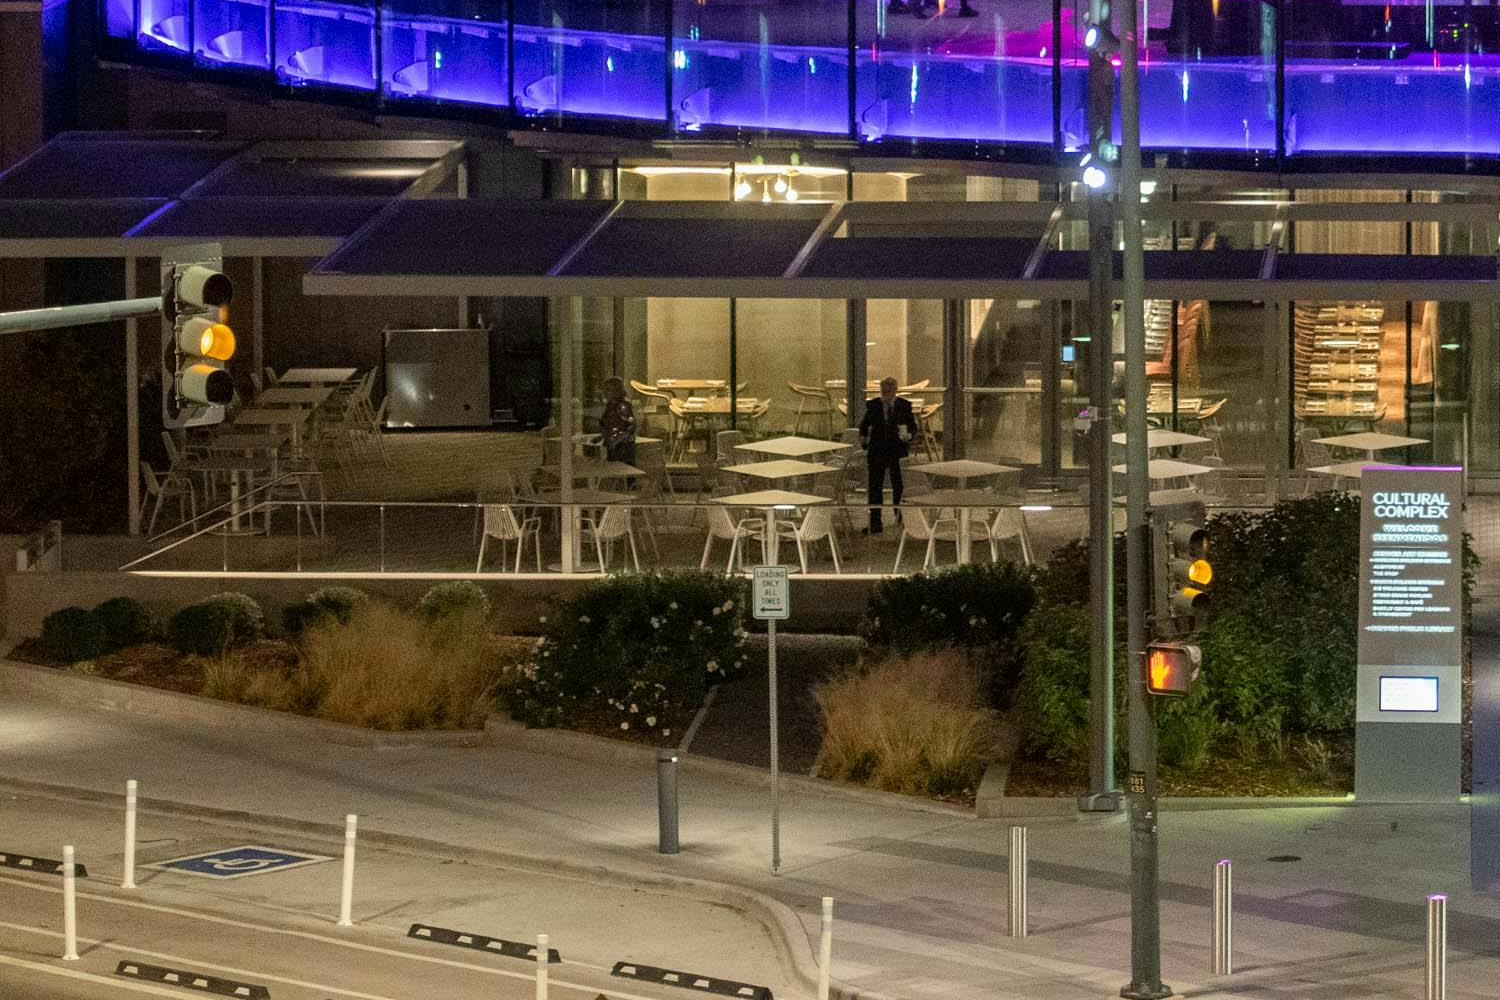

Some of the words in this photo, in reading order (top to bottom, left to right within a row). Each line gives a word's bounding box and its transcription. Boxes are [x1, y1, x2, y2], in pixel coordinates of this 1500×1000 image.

[1372, 493, 1450, 505] CULTURAL
[1373, 506, 1448, 518] COMPLEX
[1382, 524, 1439, 533] WELCOME
[1372, 533, 1449, 543] BIENVENIDOS
[762, 579, 779, 587] ONLY
[764, 588, 776, 596] ALL
